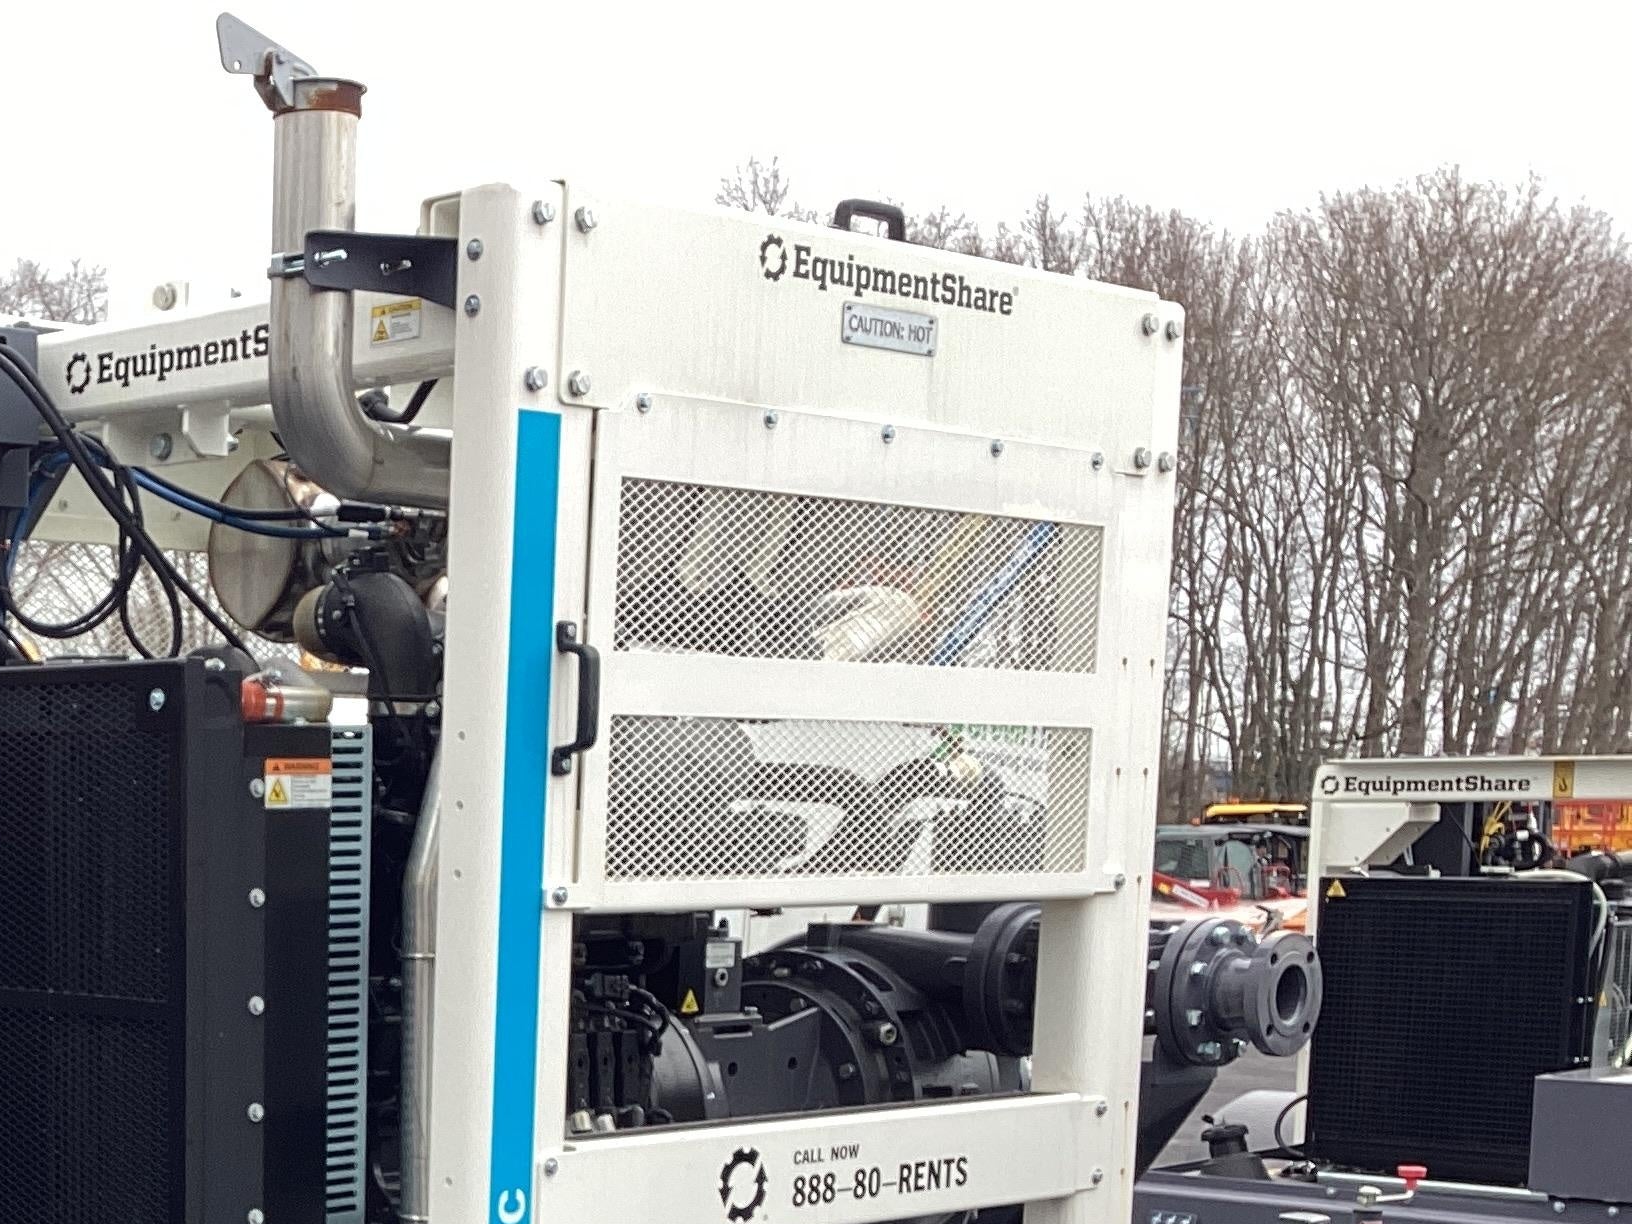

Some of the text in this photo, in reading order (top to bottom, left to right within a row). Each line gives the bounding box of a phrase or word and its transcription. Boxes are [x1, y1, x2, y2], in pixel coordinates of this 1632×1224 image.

[793, 244, 1013, 315] EquipmentShare
[848, 313, 934, 344] CAUTION: HOT
[96, 323, 269, 387] EquipmentS
[1343, 775, 1531, 796] EquipmentShare
[793, 1144, 860, 1165] CALL NOW
[792, 1157, 968, 1207] 888-80-RENTS
